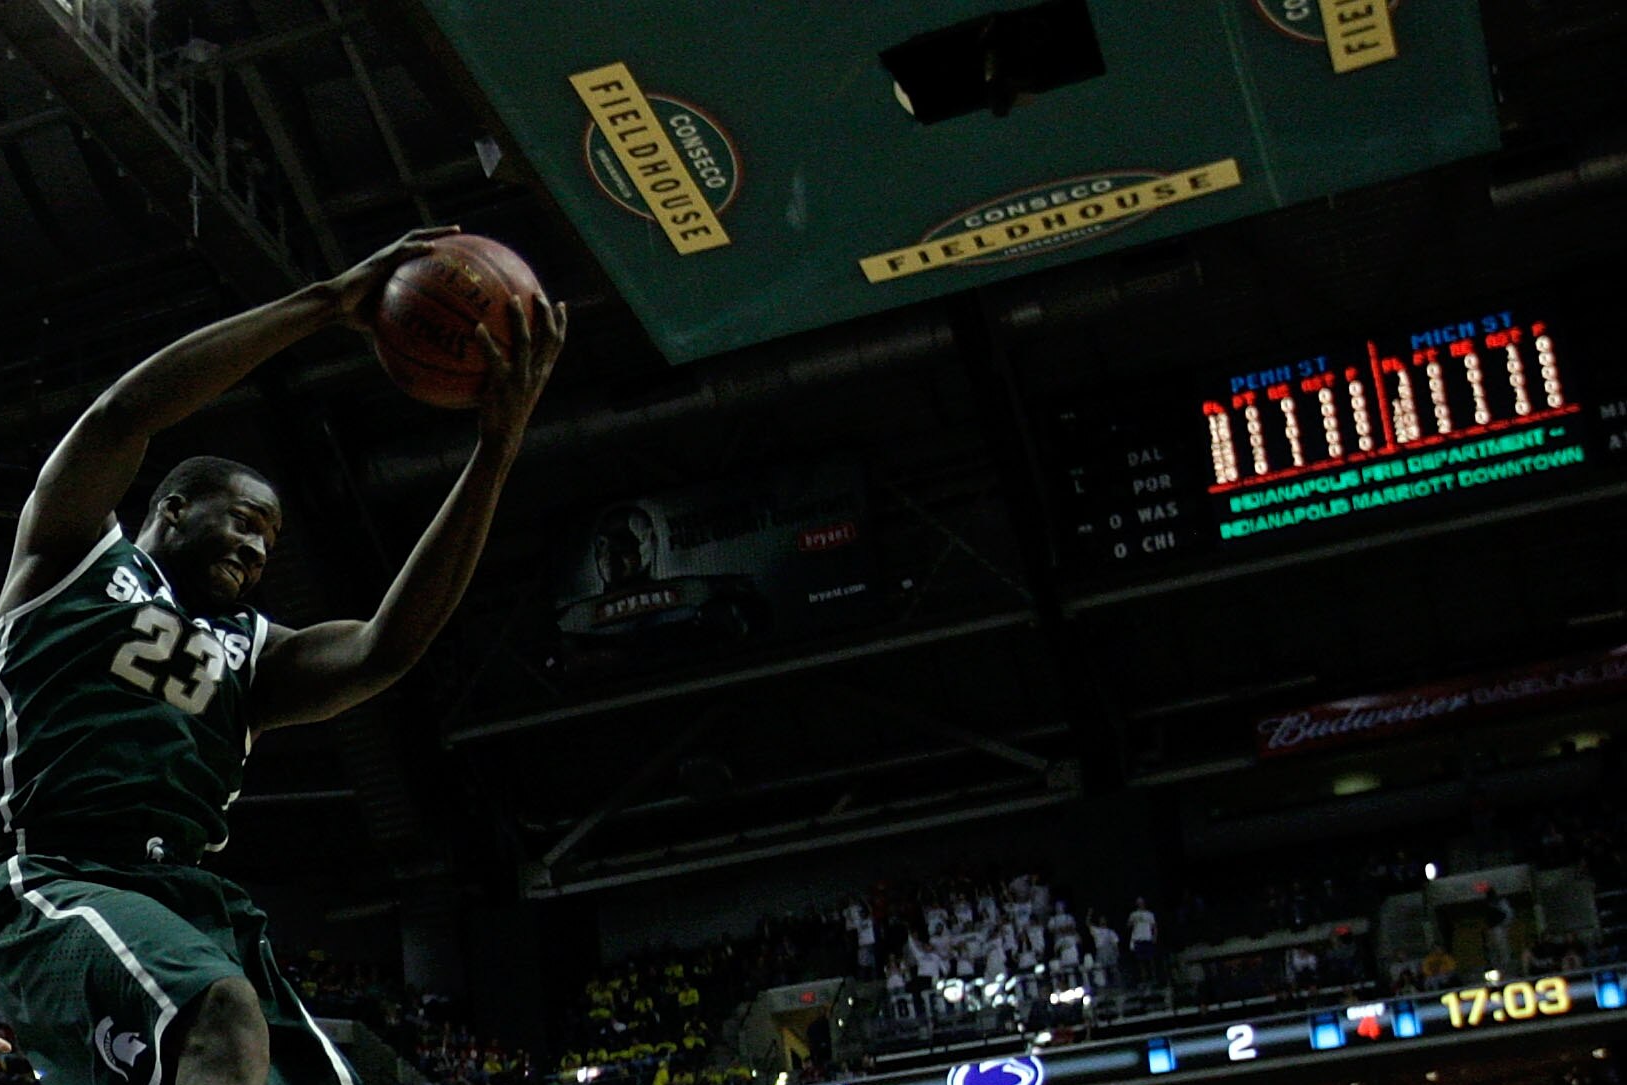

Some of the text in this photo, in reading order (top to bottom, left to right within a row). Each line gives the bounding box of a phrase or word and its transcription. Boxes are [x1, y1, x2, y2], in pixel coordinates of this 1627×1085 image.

[588, 80, 713, 242] FIELDHOUSE
[668, 113, 727, 189] CONSECO
[885, 171, 1214, 273] FIELDHOUSE
[963, 178, 1114, 228] CONSECO
[1410, 320, 1477, 350] MICH
[1481, 311, 1515, 333] ST
[1230, 367, 1291, 393] PENN
[1300, 355, 1329, 377] ST
[1127, 447, 1164, 468] DAL
[1230, 469, 1361, 513] INDIANAPOLIS
[1362, 459, 1407, 485] FIRE
[1408, 427, 1545, 473] DEPARTMENT
[1133, 473, 1172, 496] POR
[1220, 445, 1585, 540] INDIANAPOLIS MARRIOTT DOWNTOWN
[1137, 501, 1179, 524] WAS
[1141, 531, 1176, 553] CHI
[108, 605, 226, 716] 23
[1257, 693, 1470, 750] Budweiser
[1441, 976, 1571, 1029] 17:03
[1226, 1023, 1256, 1061] 2
